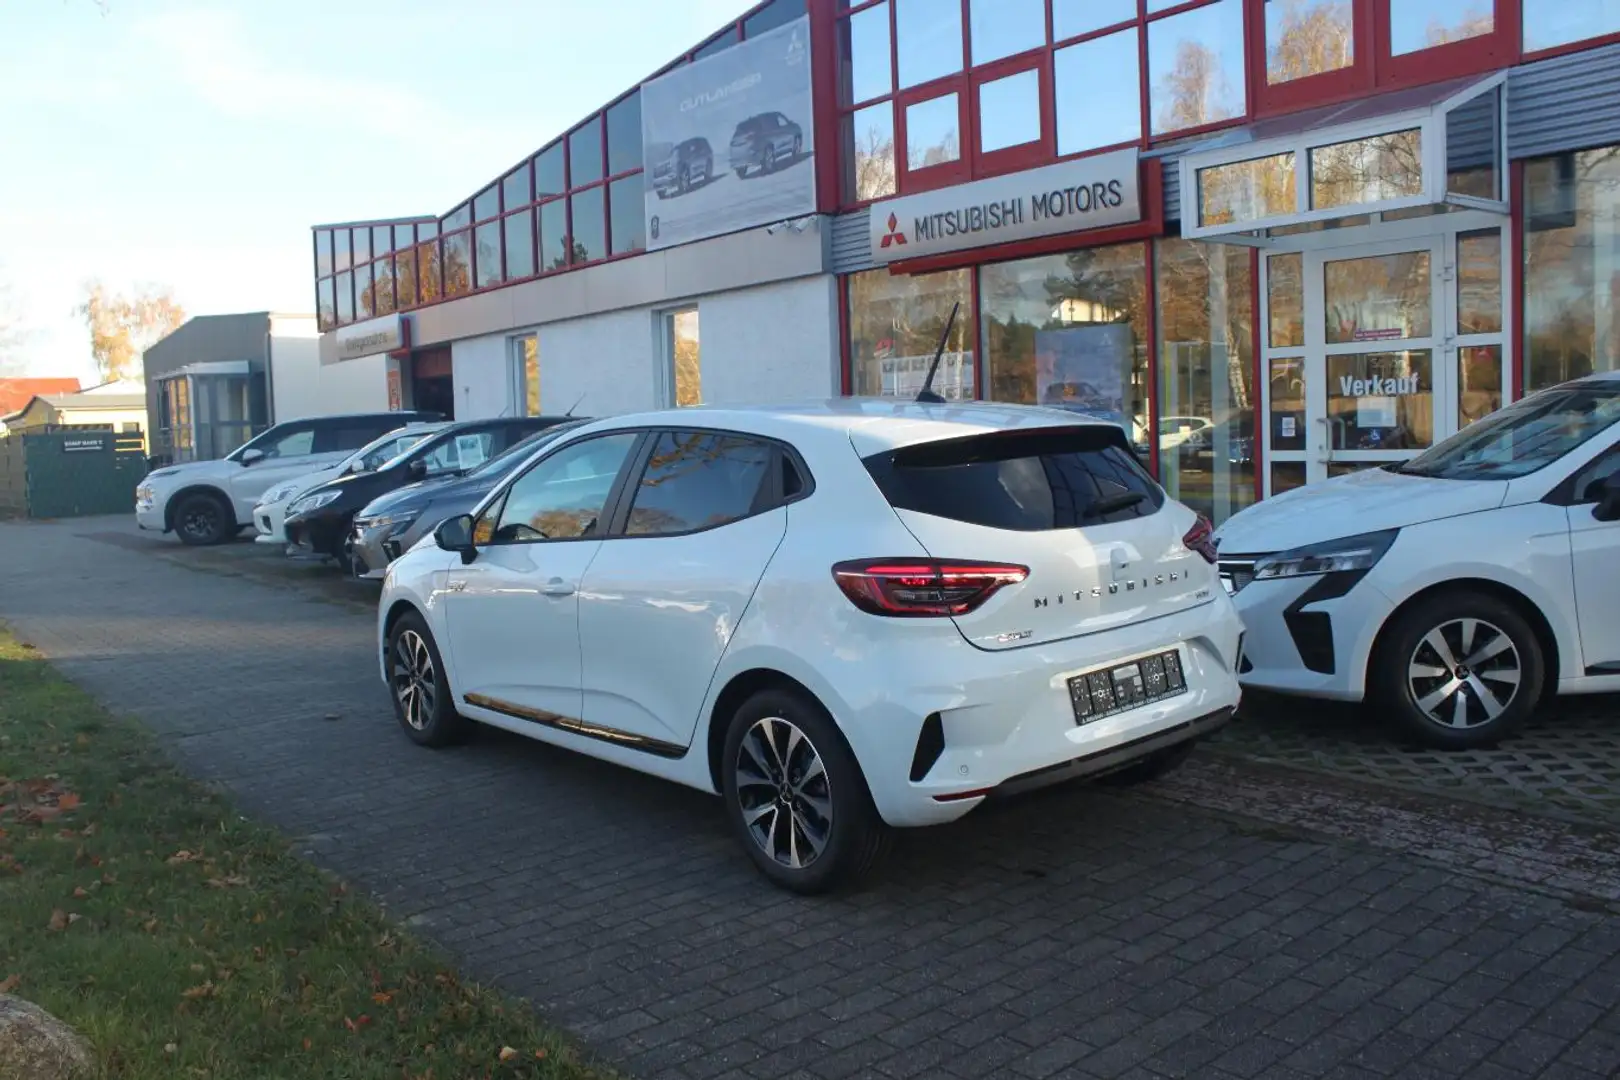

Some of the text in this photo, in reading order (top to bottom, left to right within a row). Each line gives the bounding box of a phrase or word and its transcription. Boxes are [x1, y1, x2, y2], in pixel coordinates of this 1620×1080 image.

[914, 179, 1122, 242] MITSUBISHI MOTORS
[1340, 372, 1419, 397] Verkauf
[1034, 570, 1189, 608] MITSUBISHI
